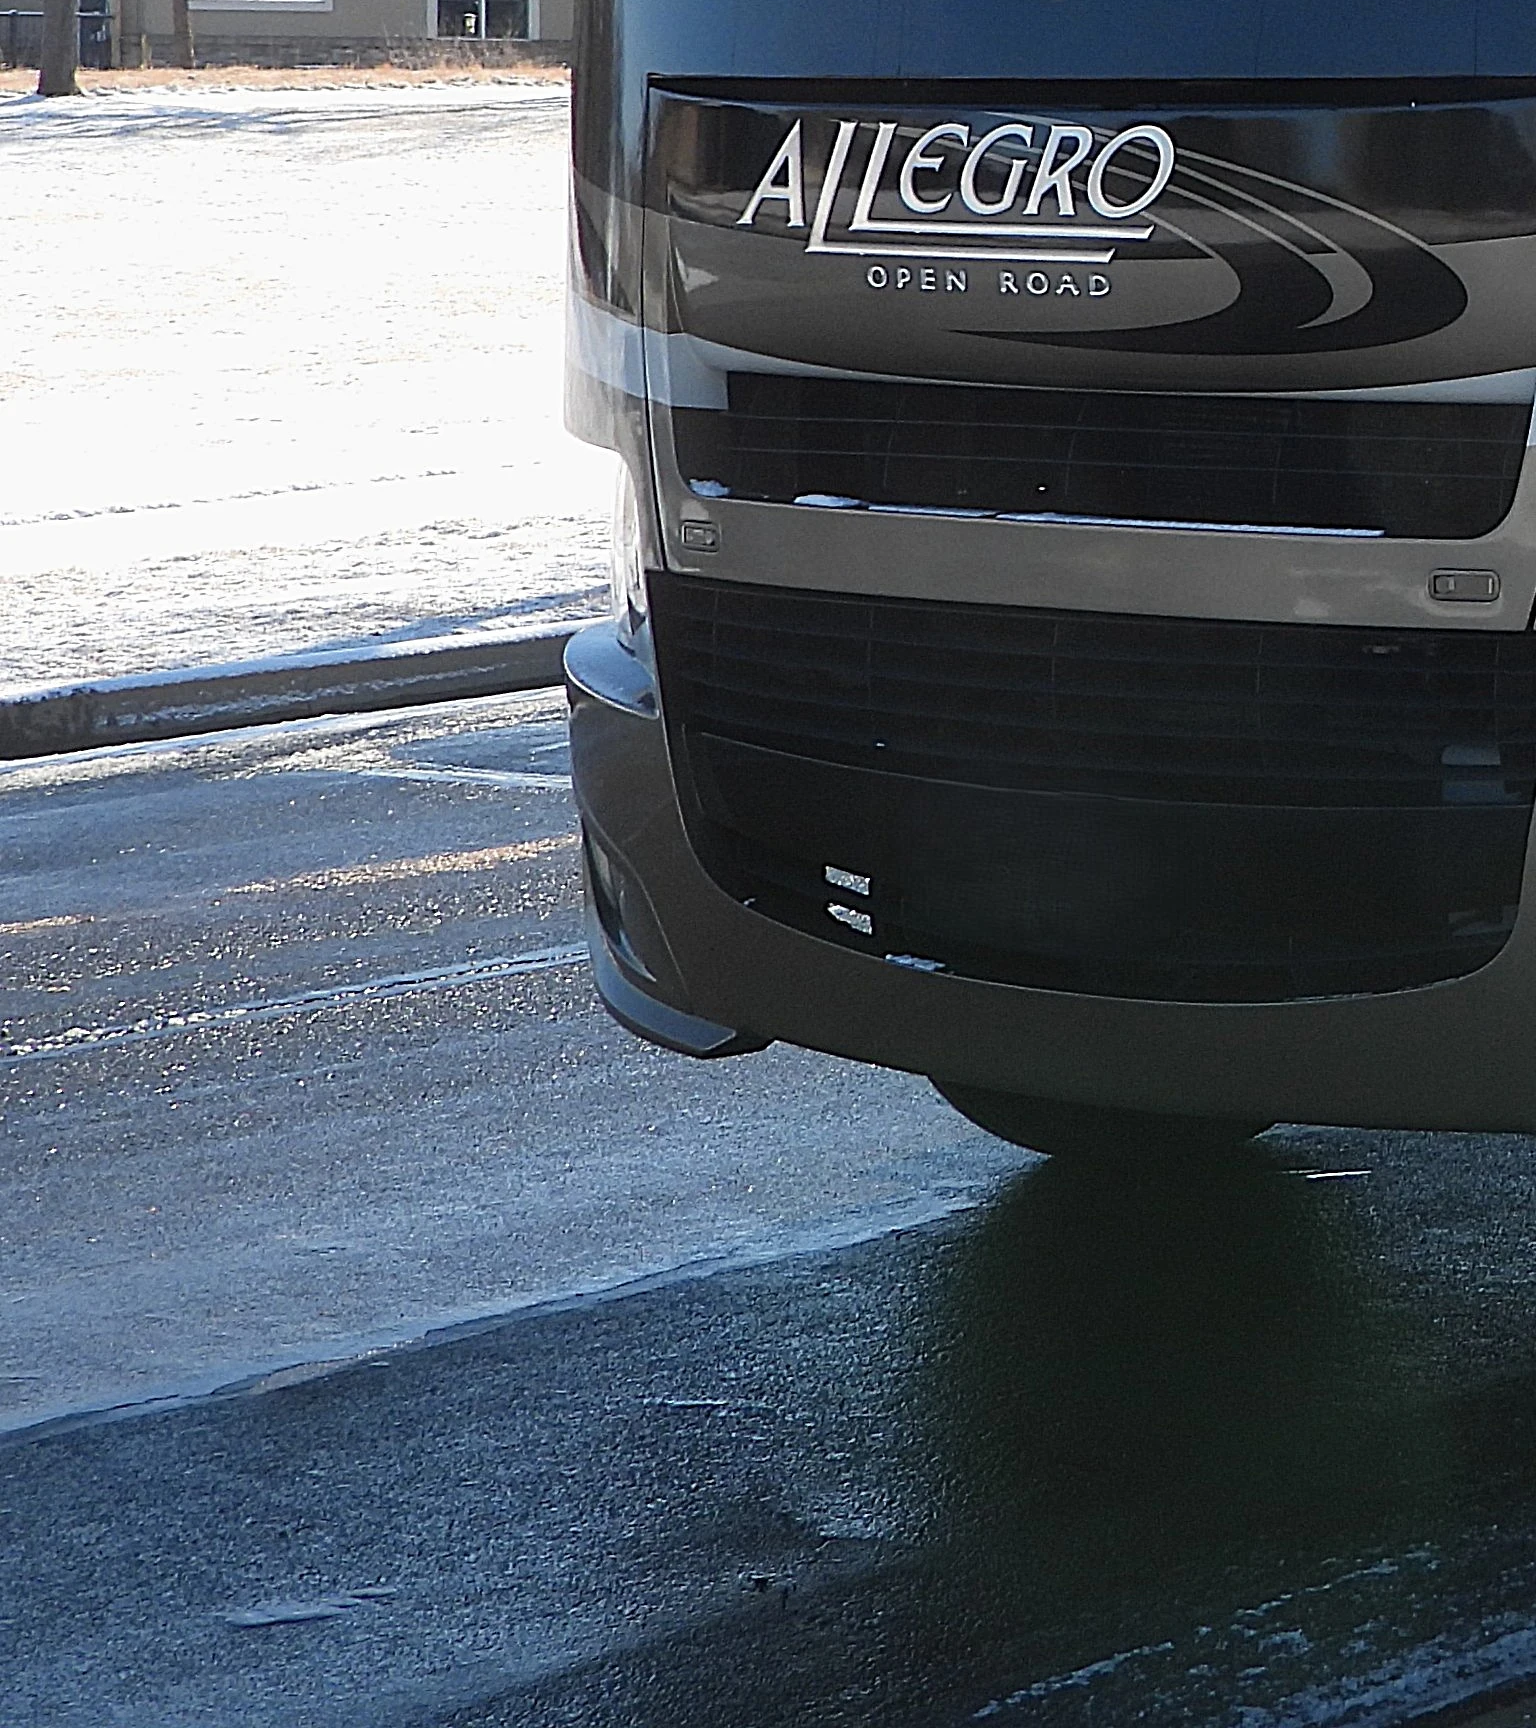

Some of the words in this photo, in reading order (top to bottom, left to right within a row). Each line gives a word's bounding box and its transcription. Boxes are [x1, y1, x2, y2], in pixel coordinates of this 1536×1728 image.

[736, 117, 1176, 264] ALLEGRO
[866, 265, 968, 292] OPEN
[999, 271, 1112, 297] ROAD
